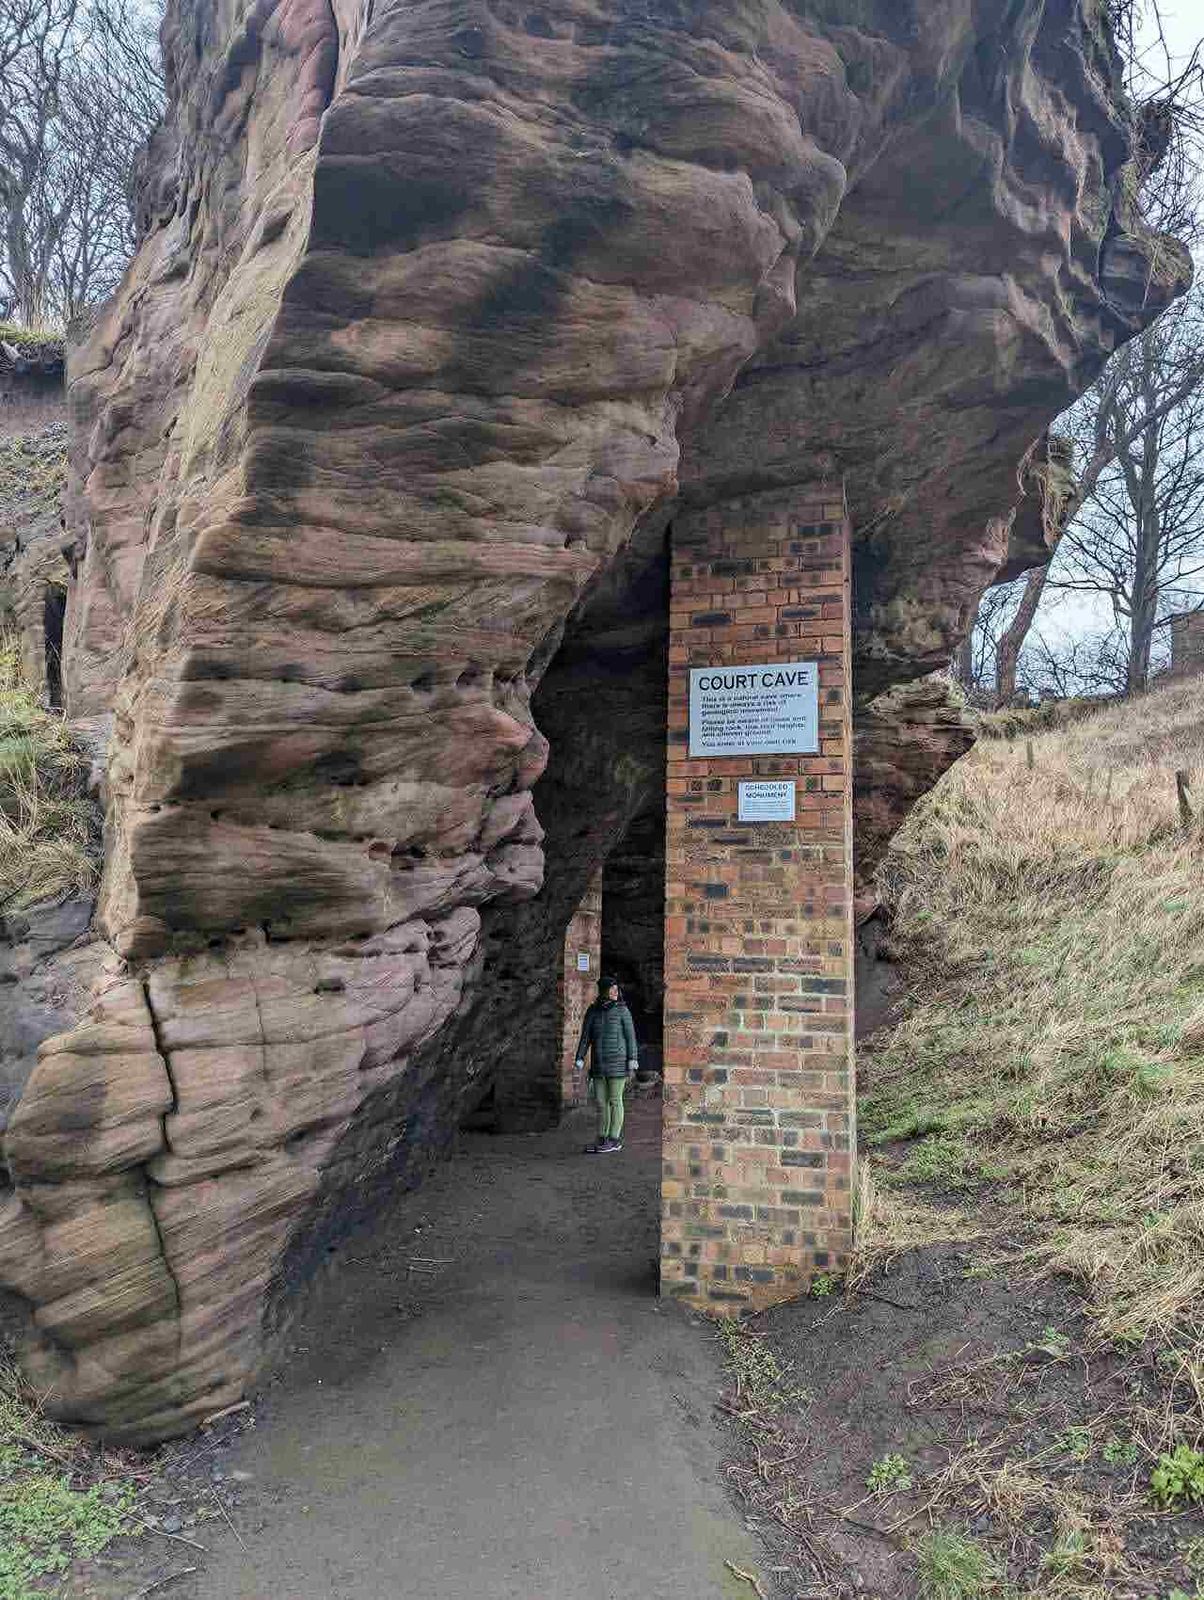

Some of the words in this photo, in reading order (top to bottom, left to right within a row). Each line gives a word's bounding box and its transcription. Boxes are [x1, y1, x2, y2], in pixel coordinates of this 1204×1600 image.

[699, 674, 757, 690] COURT
[761, 671, 809, 688] CAVE
[701, 740, 715, 748] You
[745, 783, 789, 791] SCHEDULED
[745, 791, 788, 799] MONUMENT
